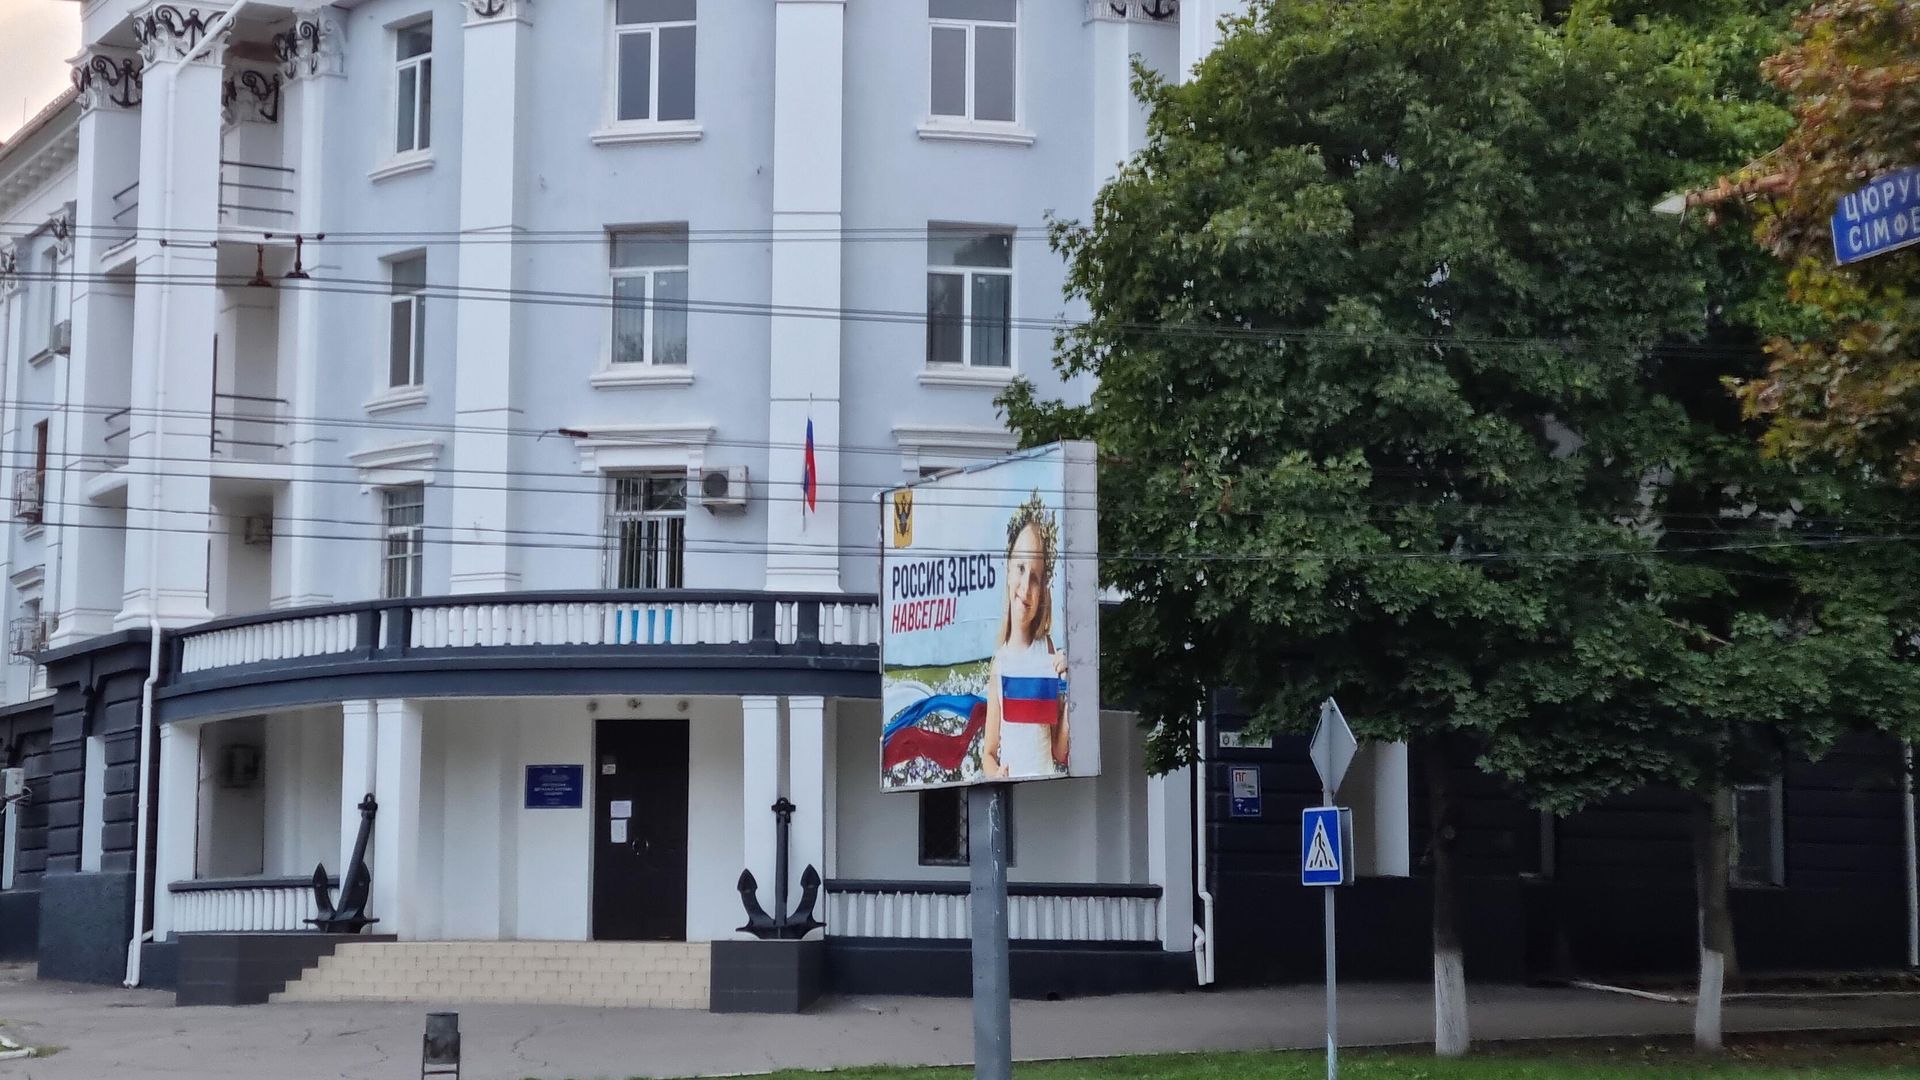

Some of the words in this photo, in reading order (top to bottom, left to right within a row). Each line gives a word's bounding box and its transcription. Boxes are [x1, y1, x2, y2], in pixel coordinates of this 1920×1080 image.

[892, 559, 945, 601] РОССИЯ
[948, 553, 996, 597] ЗДЕСЬ
[891, 597, 957, 634] НАВСЕГДА!
